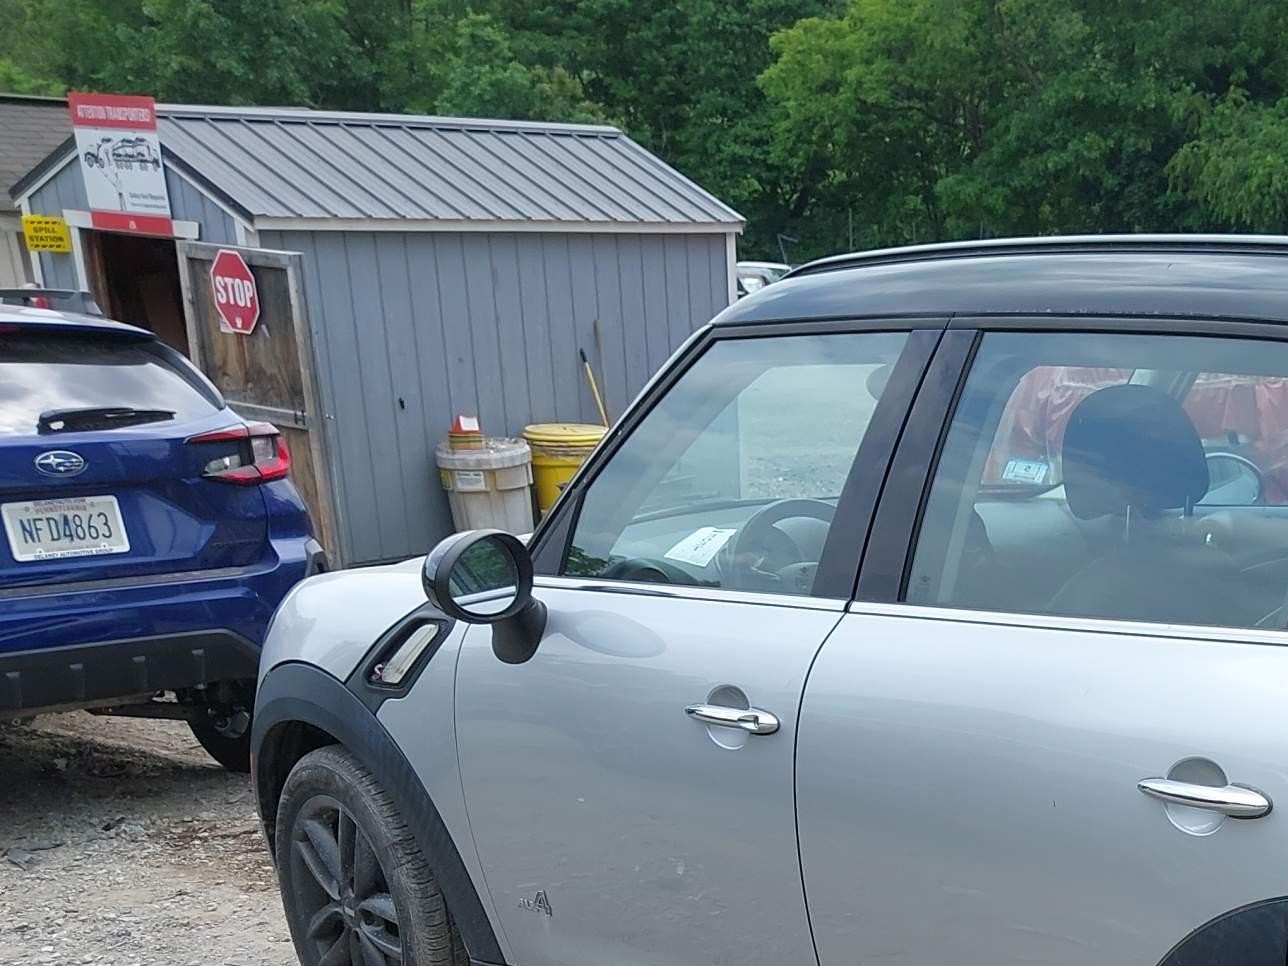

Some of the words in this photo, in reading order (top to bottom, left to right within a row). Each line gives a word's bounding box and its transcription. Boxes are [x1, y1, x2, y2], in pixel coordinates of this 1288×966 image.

[29, 235, 64, 243] STATION
[33, 226, 56, 234] SPILL
[215, 276, 253, 308] STOP
[19, 511, 113, 544] NFD4863
